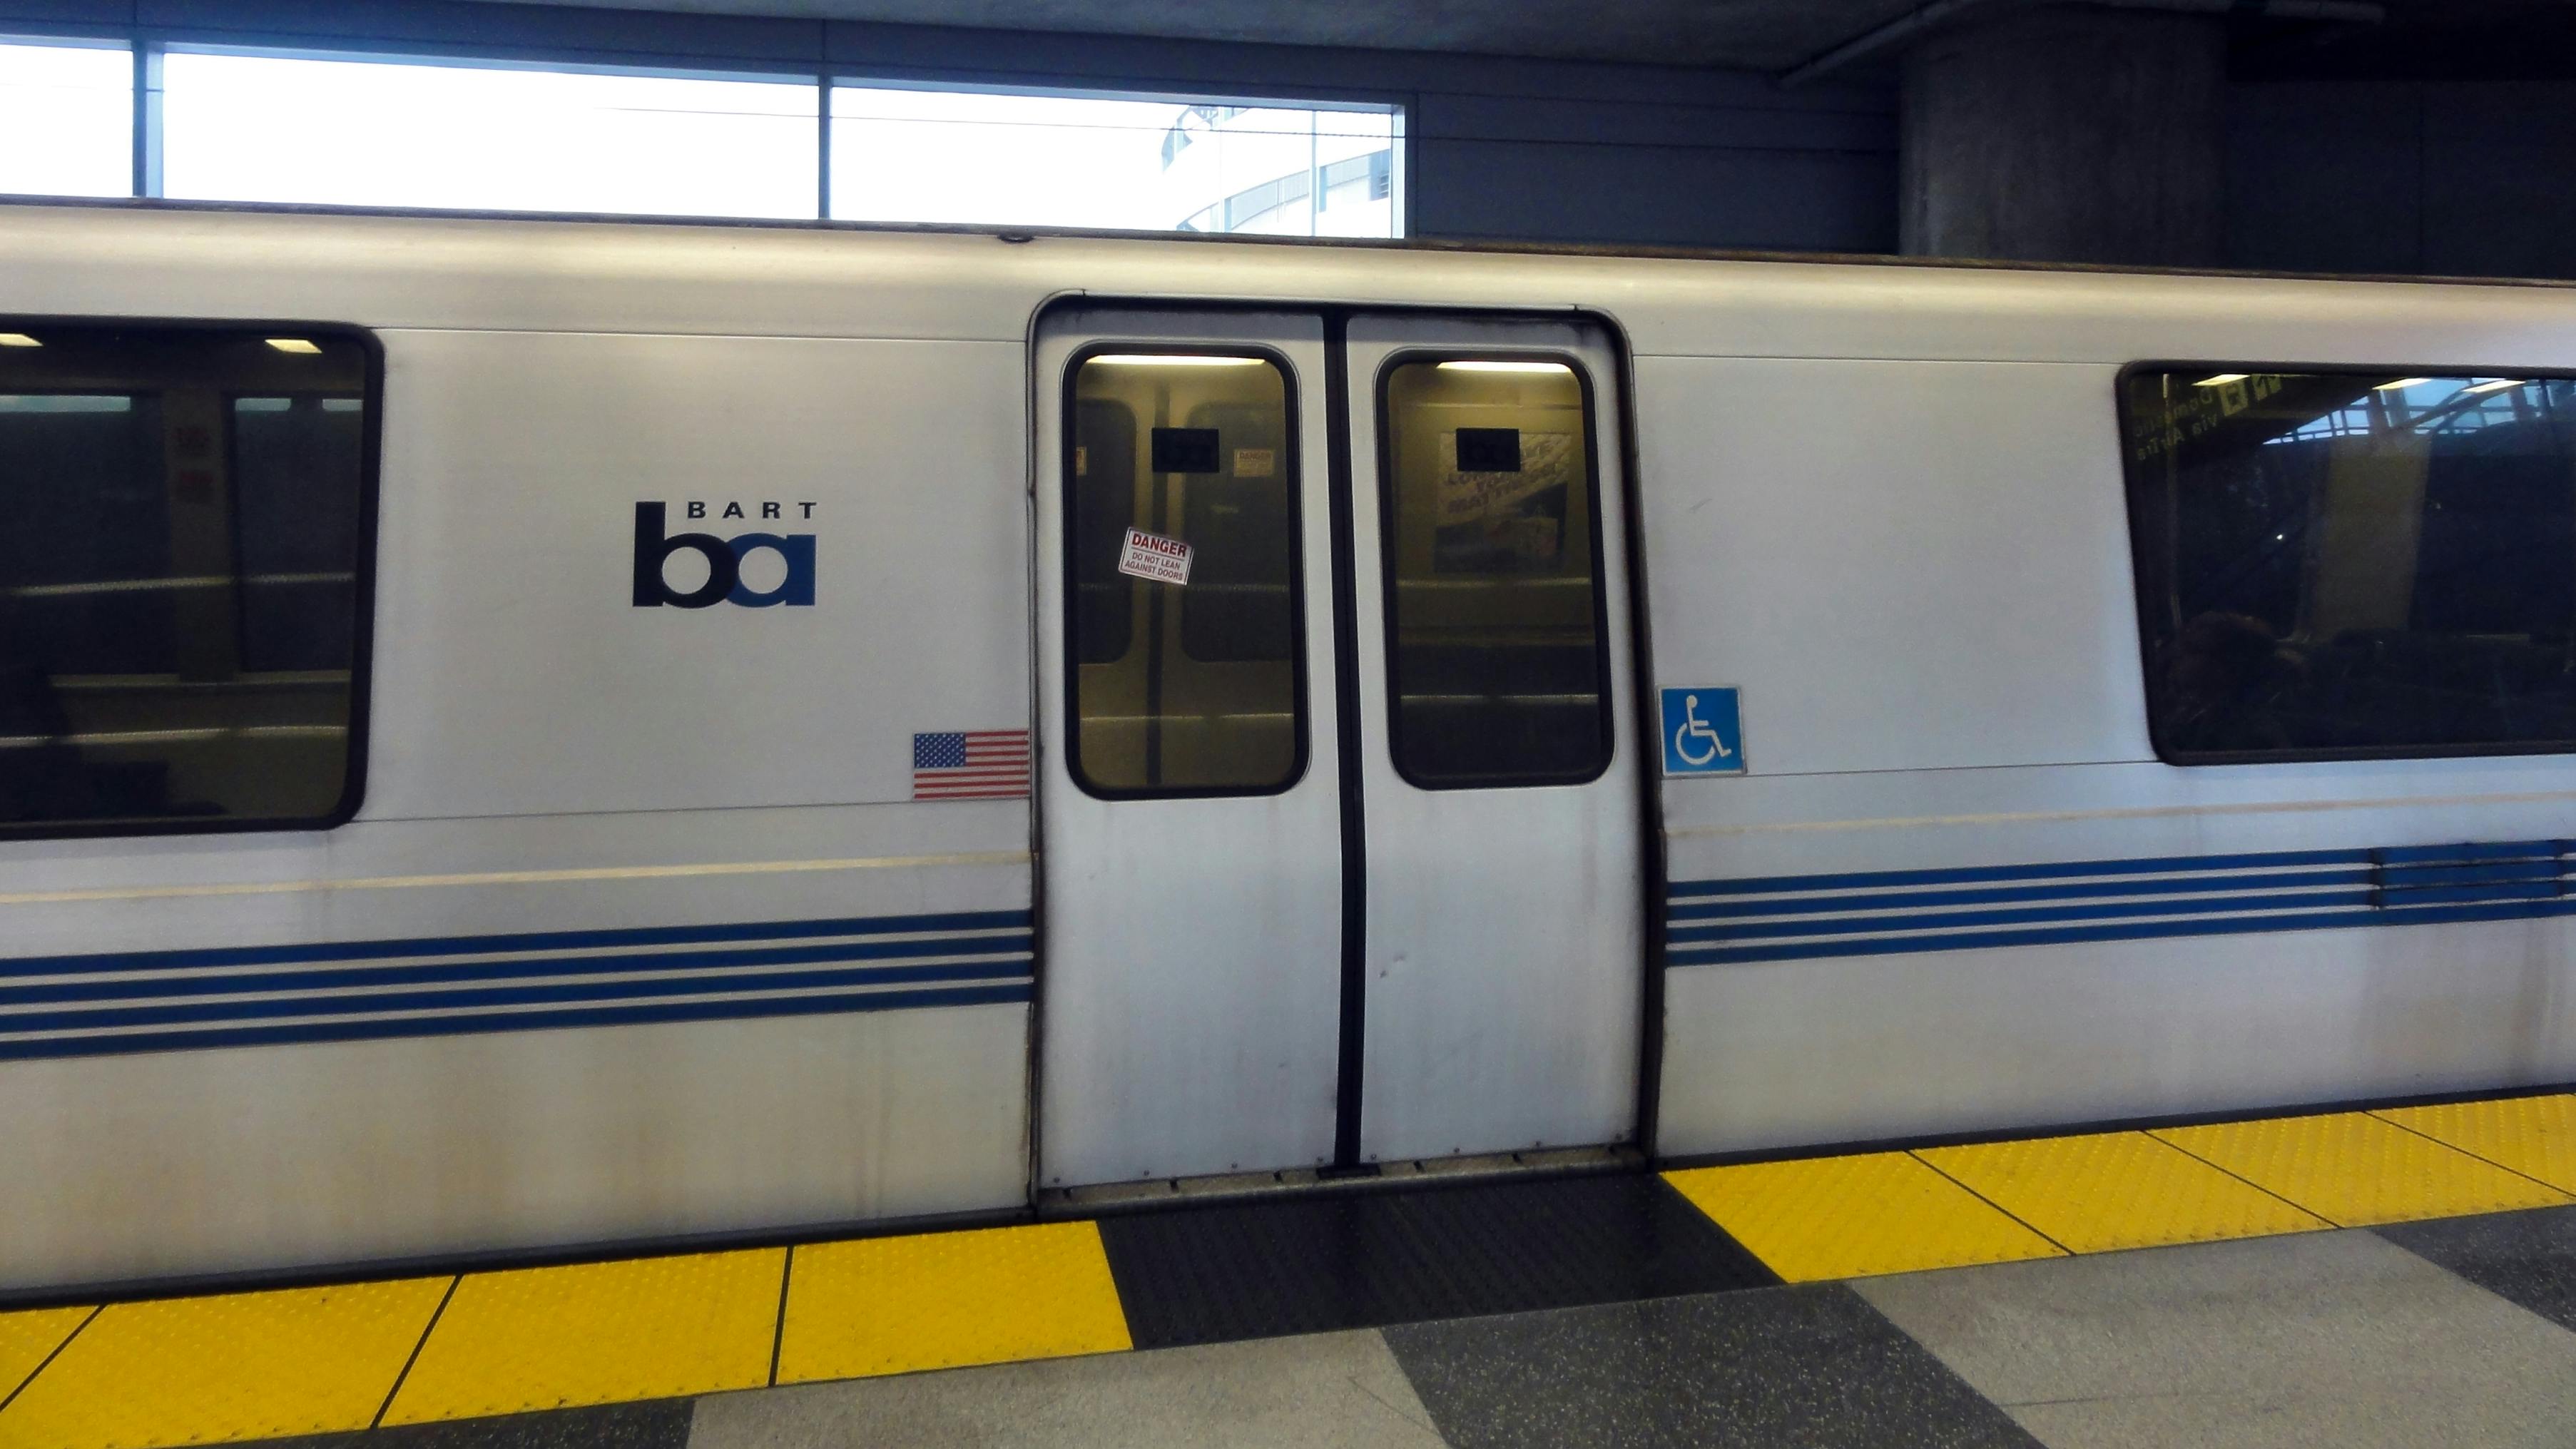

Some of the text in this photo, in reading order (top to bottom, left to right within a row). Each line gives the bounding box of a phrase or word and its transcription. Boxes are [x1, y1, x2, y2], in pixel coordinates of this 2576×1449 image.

[687, 501, 818, 519] BART
[1131, 533, 1187, 557] DANGER
[1125, 560, 1183, 581] AGAINST DOORS
[1132, 552, 1180, 570] DO NOT LEAN
